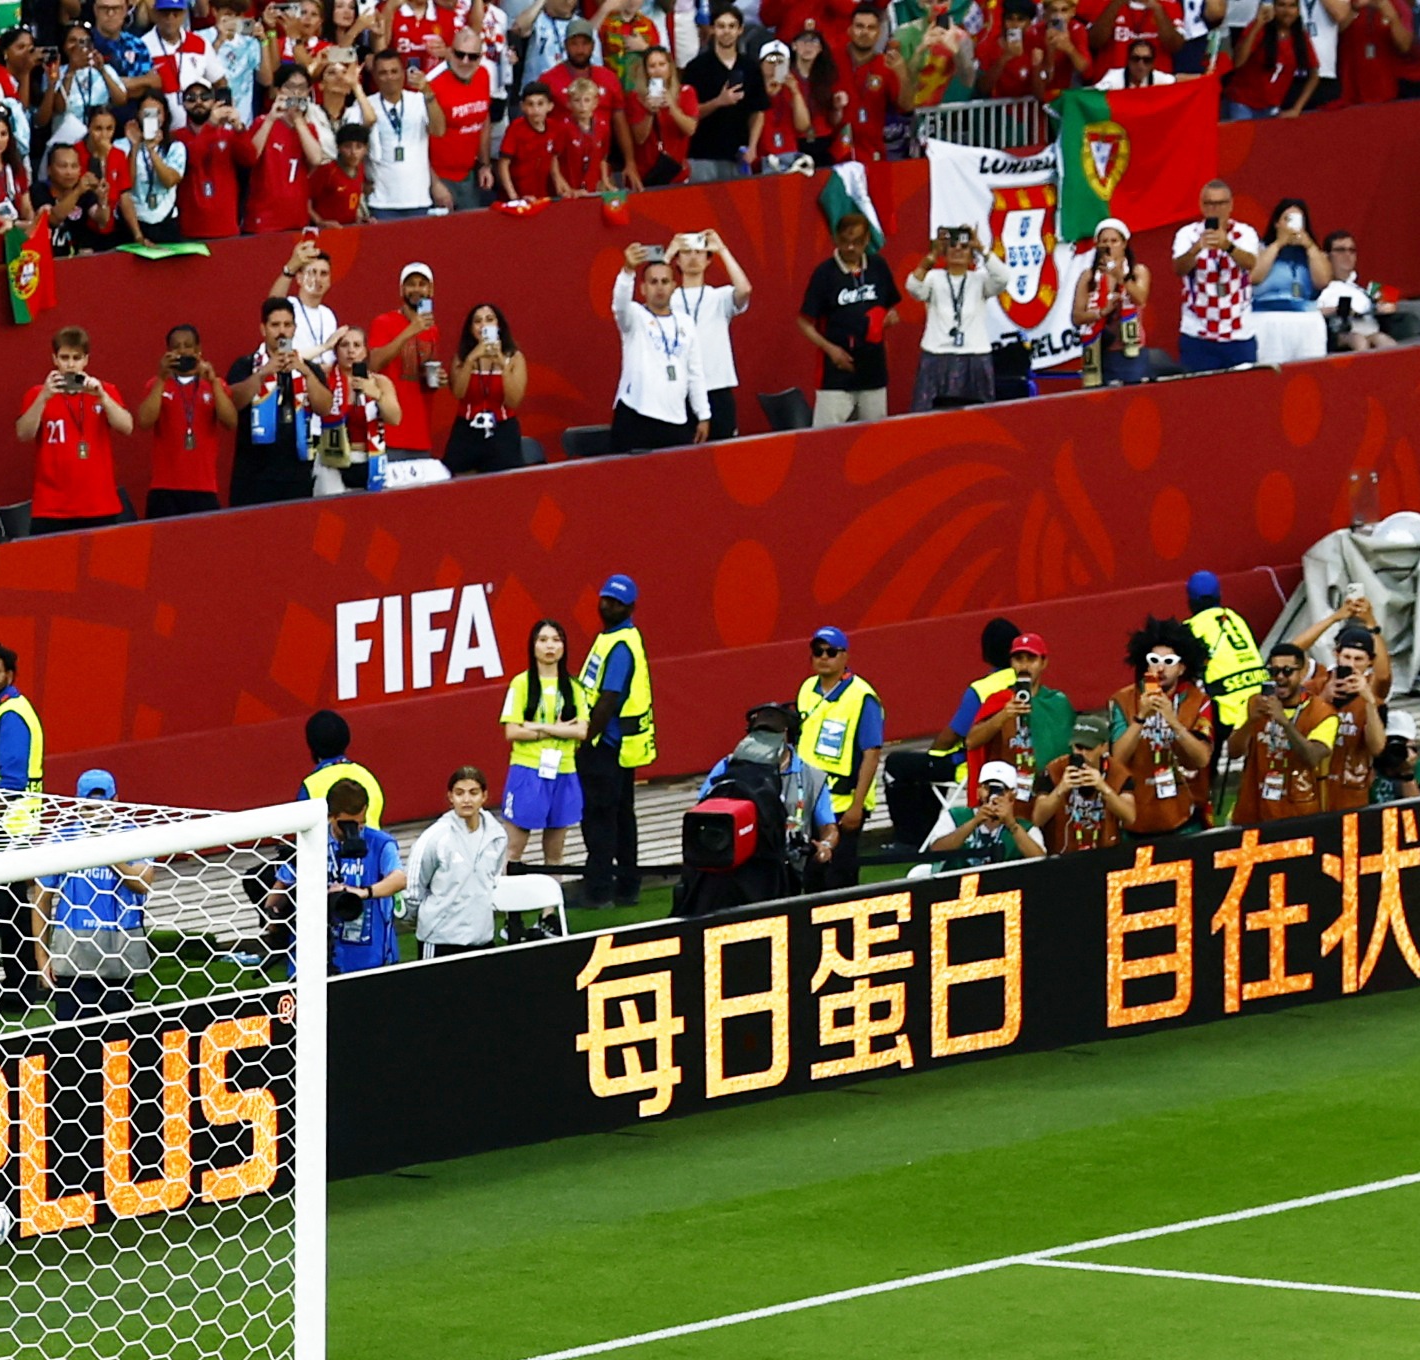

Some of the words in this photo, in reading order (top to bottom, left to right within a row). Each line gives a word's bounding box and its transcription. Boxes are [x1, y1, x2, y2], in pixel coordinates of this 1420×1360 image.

[46, 419, 66, 444] 21
[336, 583, 505, 701] FIFA
[576, 874, 1023, 1117] 每日蛋白
